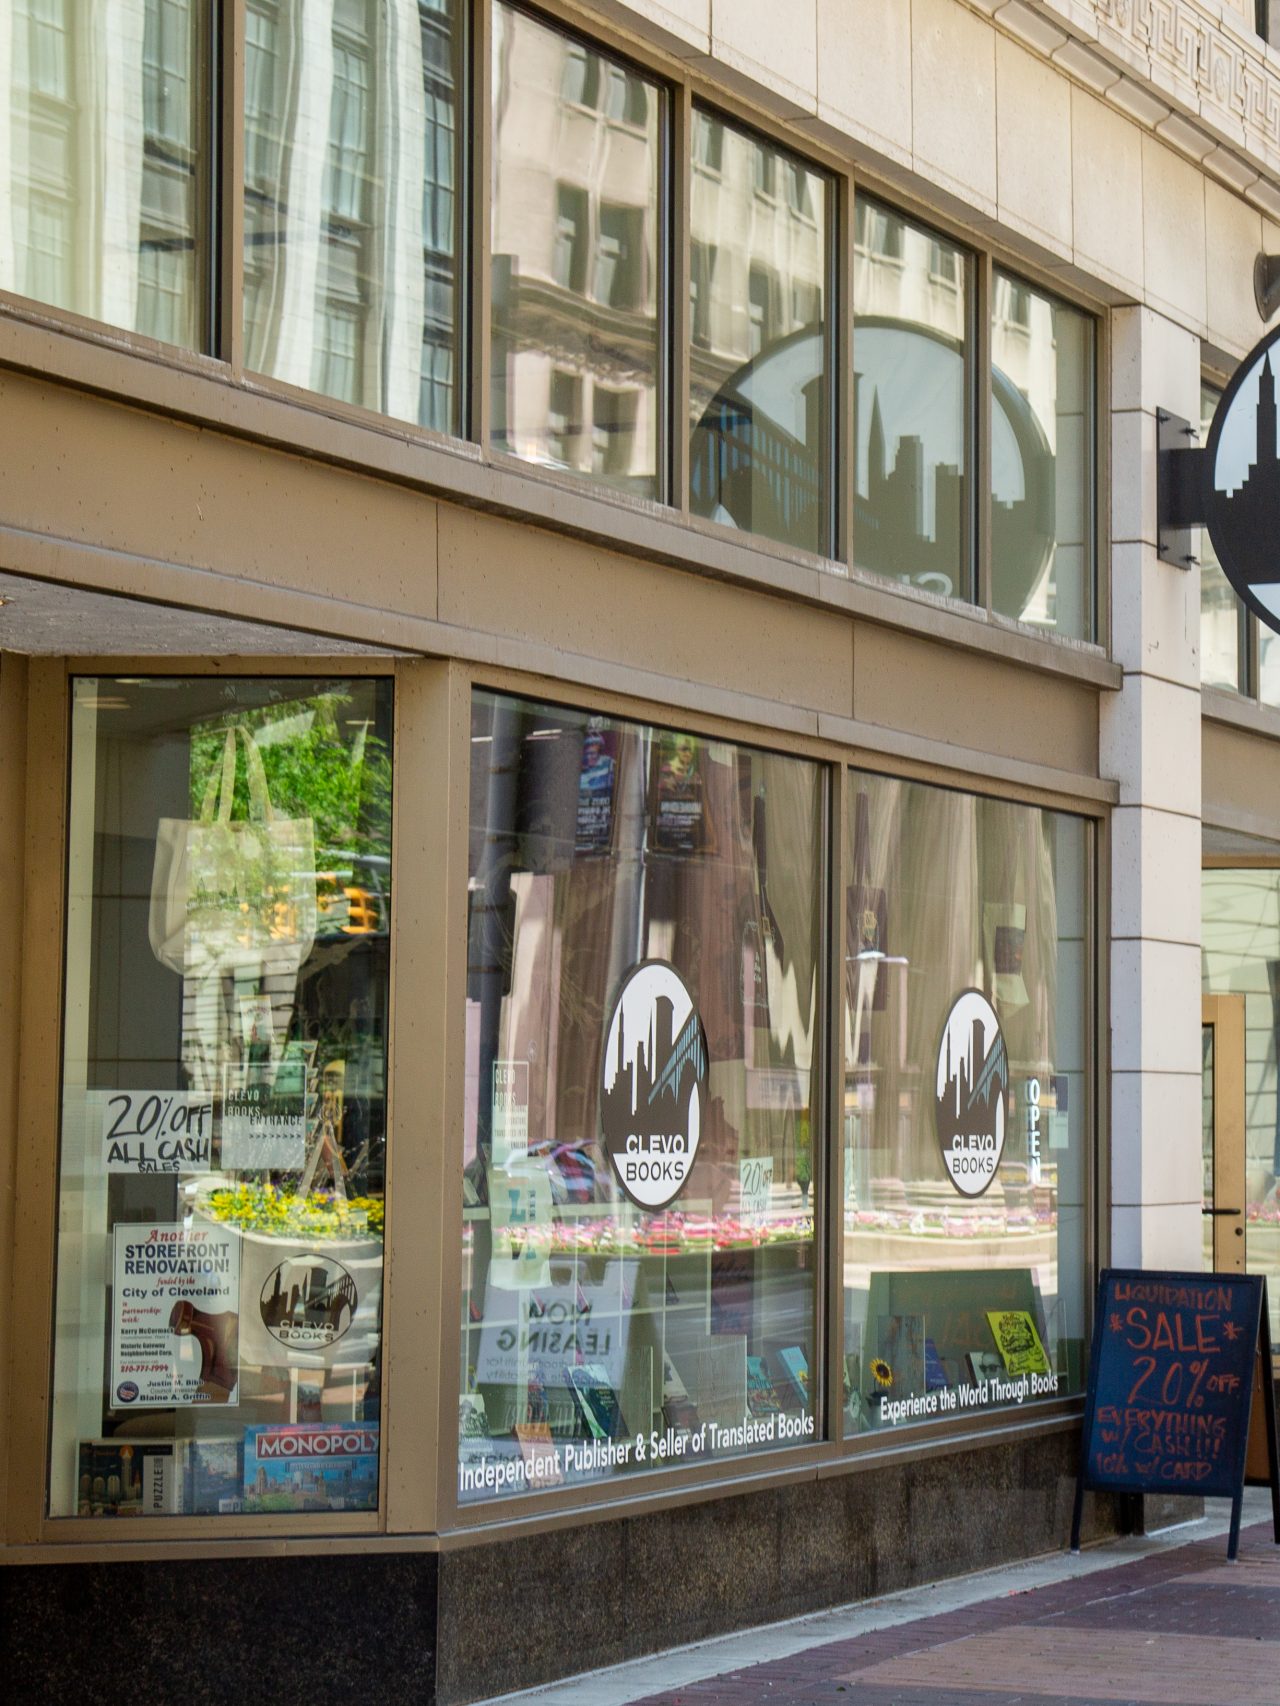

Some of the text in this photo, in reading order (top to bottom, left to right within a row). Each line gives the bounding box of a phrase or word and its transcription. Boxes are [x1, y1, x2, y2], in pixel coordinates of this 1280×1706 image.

[228, 1090, 259, 1101] CLEVO
[228, 1106, 260, 1117] BOOKS
[250, 1116, 302, 1126] ENTRANCE
[1028, 1079, 1041, 1184] OPEN
[107, 1138, 209, 1163] ALL CASH
[626, 1134, 685, 1154] CLEVO
[952, 1134, 994, 1150] CLEVO
[138, 1160, 180, 1172] SALES
[626, 1161, 684, 1182] BOOKS
[952, 1156, 994, 1174] BOOKS
[125, 1244, 229, 1259] STOREFRONT
[125, 1259, 229, 1274] RENOVATION!
[122, 1286, 230, 1299] City of Cleveland
[280, 1319, 335, 1331] CLEVO
[279, 1330, 334, 1342] BOOKS
[1128, 1356, 1240, 1408] 20% OFF
[880, 1367, 1059, 1425] Experience the World Through Books
[1097, 1406, 1227, 1438] EVERYTHING
[260, 1433, 379, 1456] MONOPOLY
[459, 1408, 814, 1493] Independent Publisher & Seller of Translated Books
[153, 1469, 163, 1508] PUZZLE
